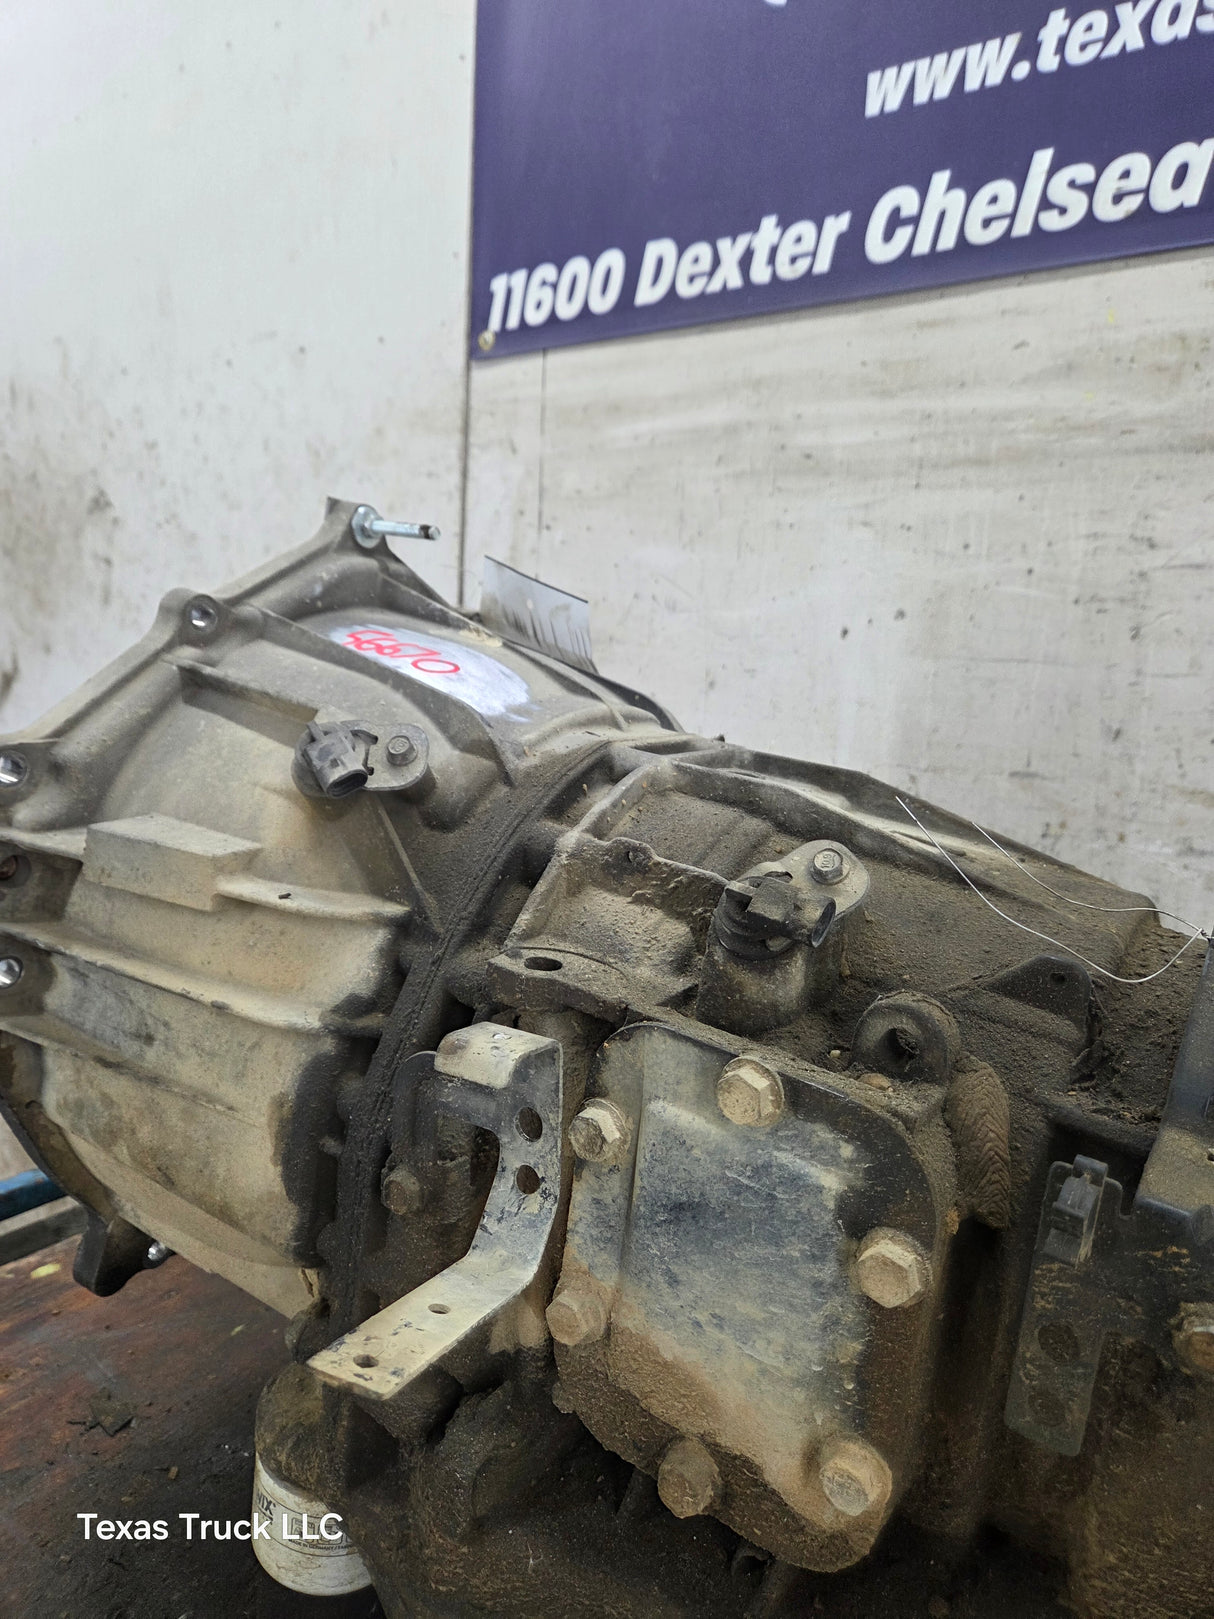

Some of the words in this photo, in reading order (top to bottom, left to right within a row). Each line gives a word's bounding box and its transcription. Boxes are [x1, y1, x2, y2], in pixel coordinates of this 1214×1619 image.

[487, 248, 625, 333] 11600
[634, 211, 852, 307] Dexter
[864, 138, 1214, 264] Chelsea
